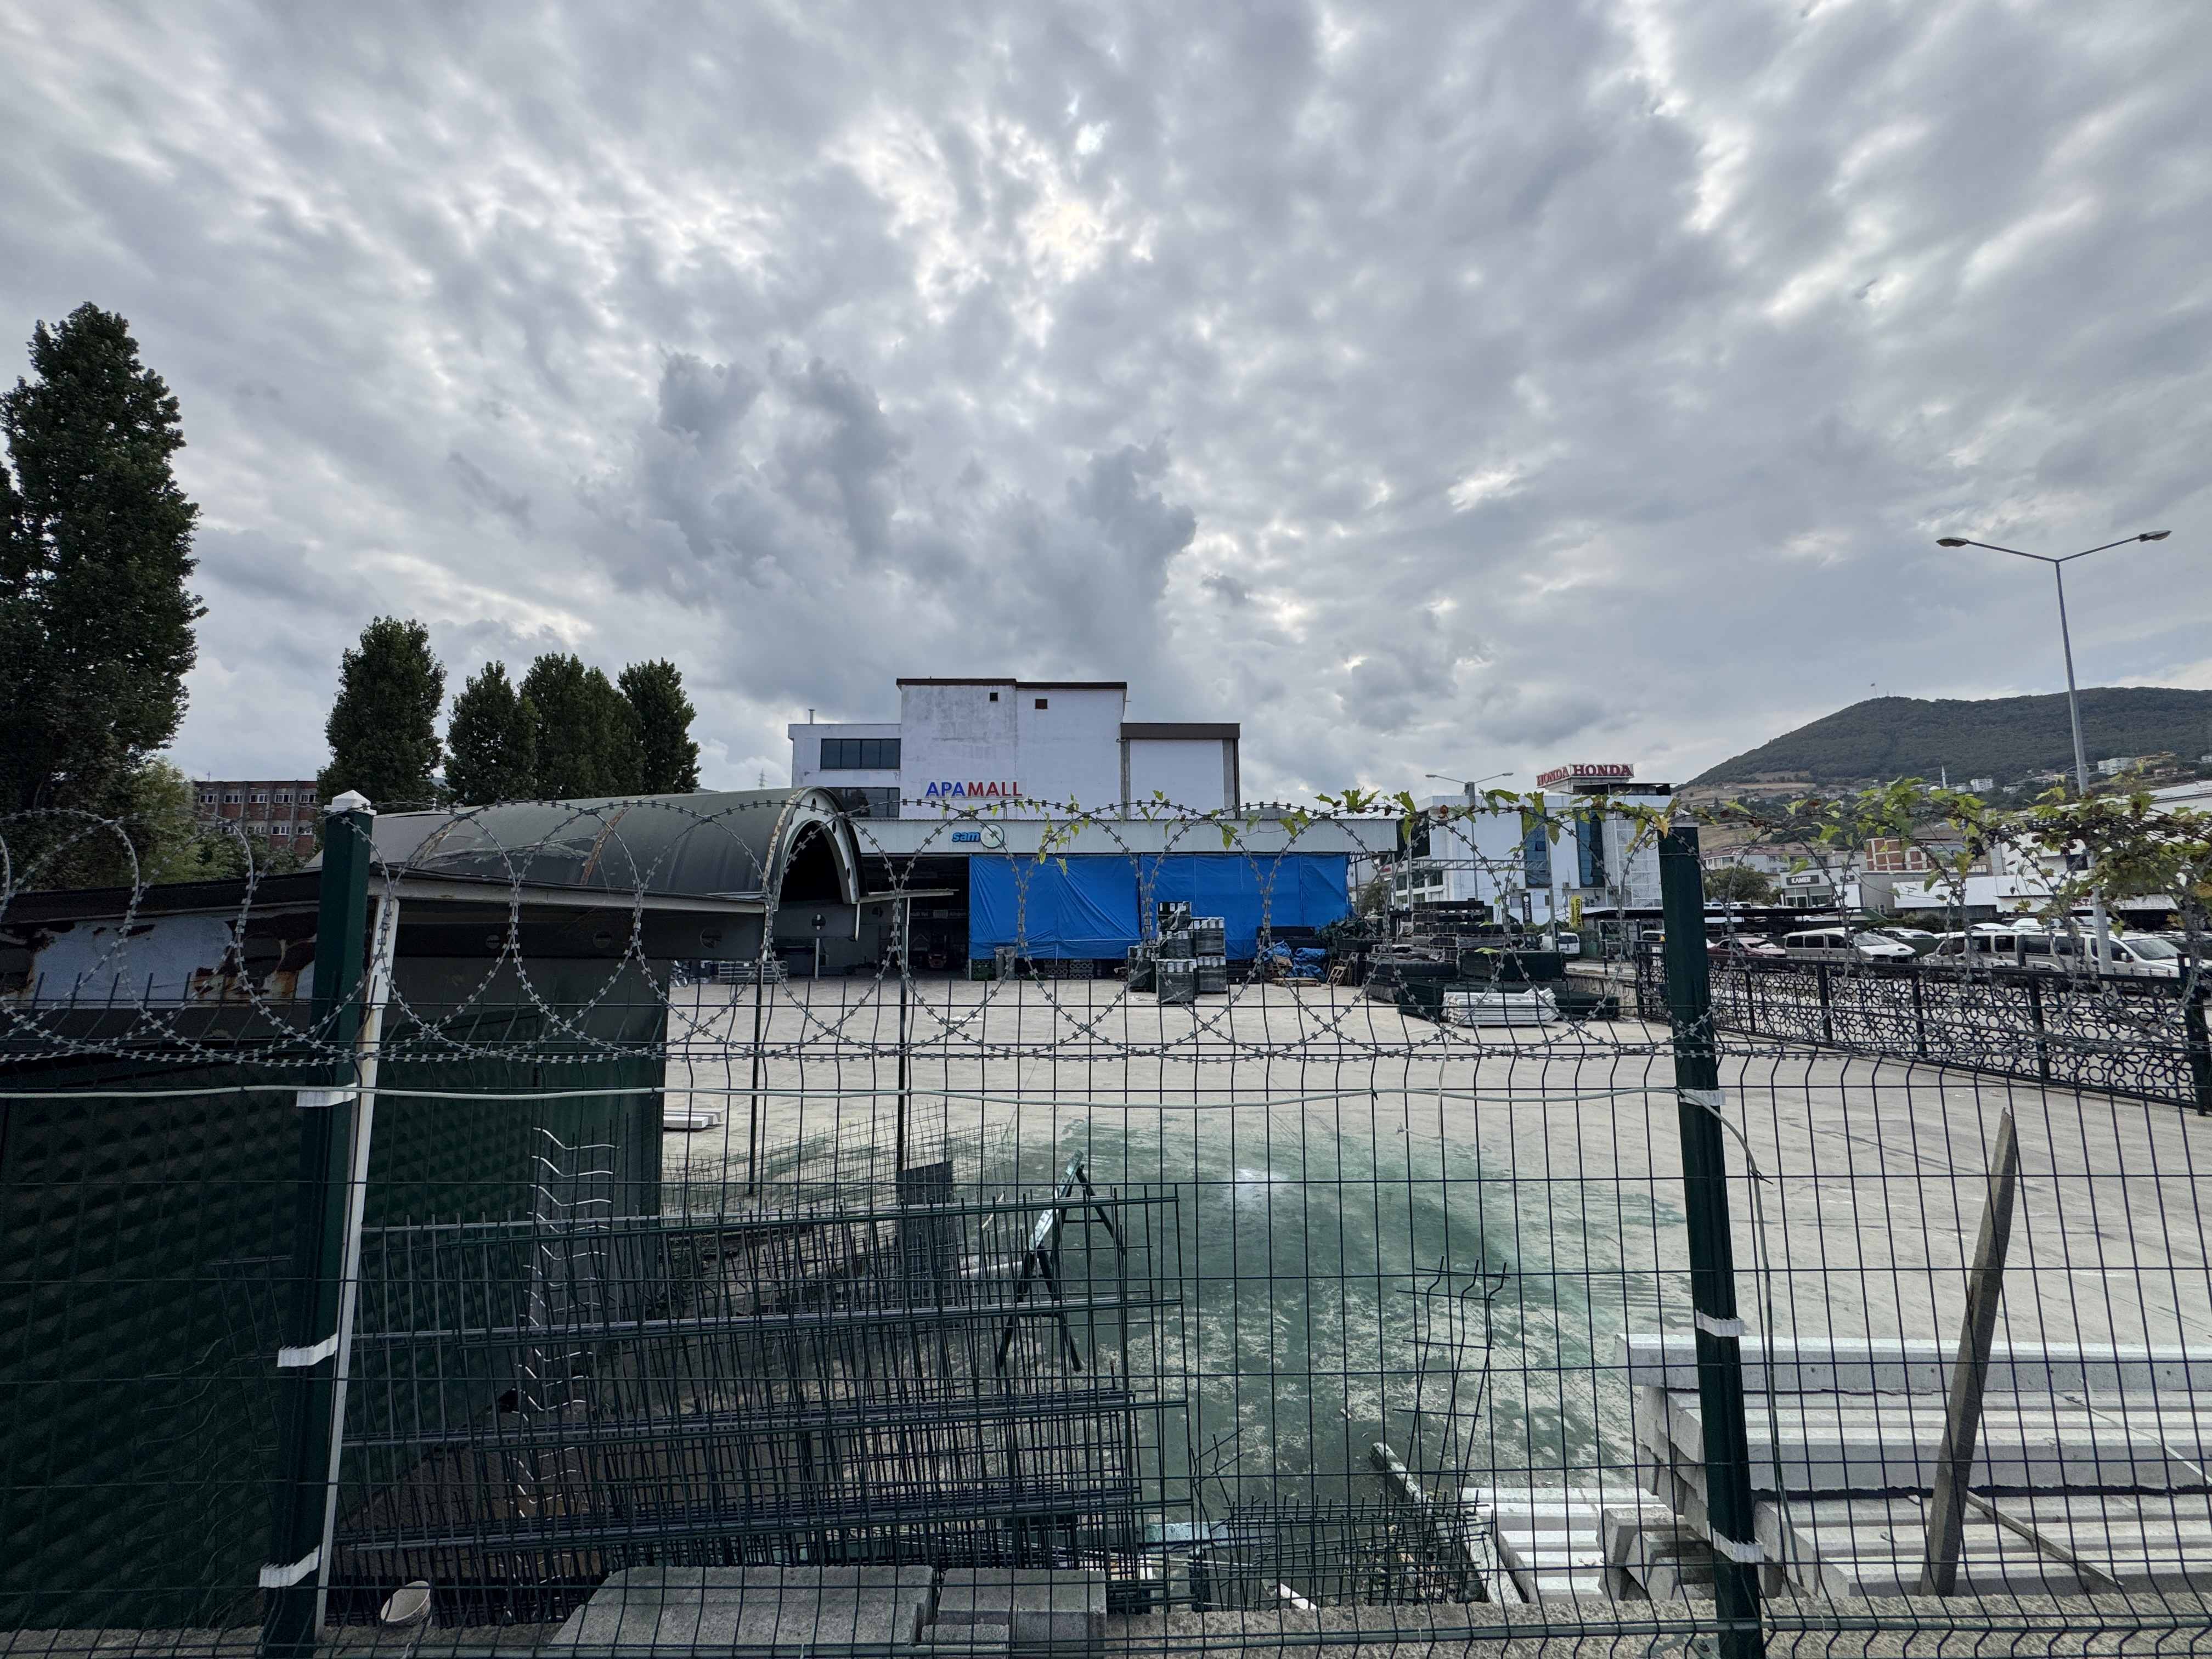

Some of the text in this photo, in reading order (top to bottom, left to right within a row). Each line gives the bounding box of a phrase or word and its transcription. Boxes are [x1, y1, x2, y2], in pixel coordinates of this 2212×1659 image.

[1537, 767, 1570, 786] HONDA
[1573, 765, 1633, 776] HONDA
[926, 781, 1023, 797] APAMALL
[952, 832, 980, 843] sam
